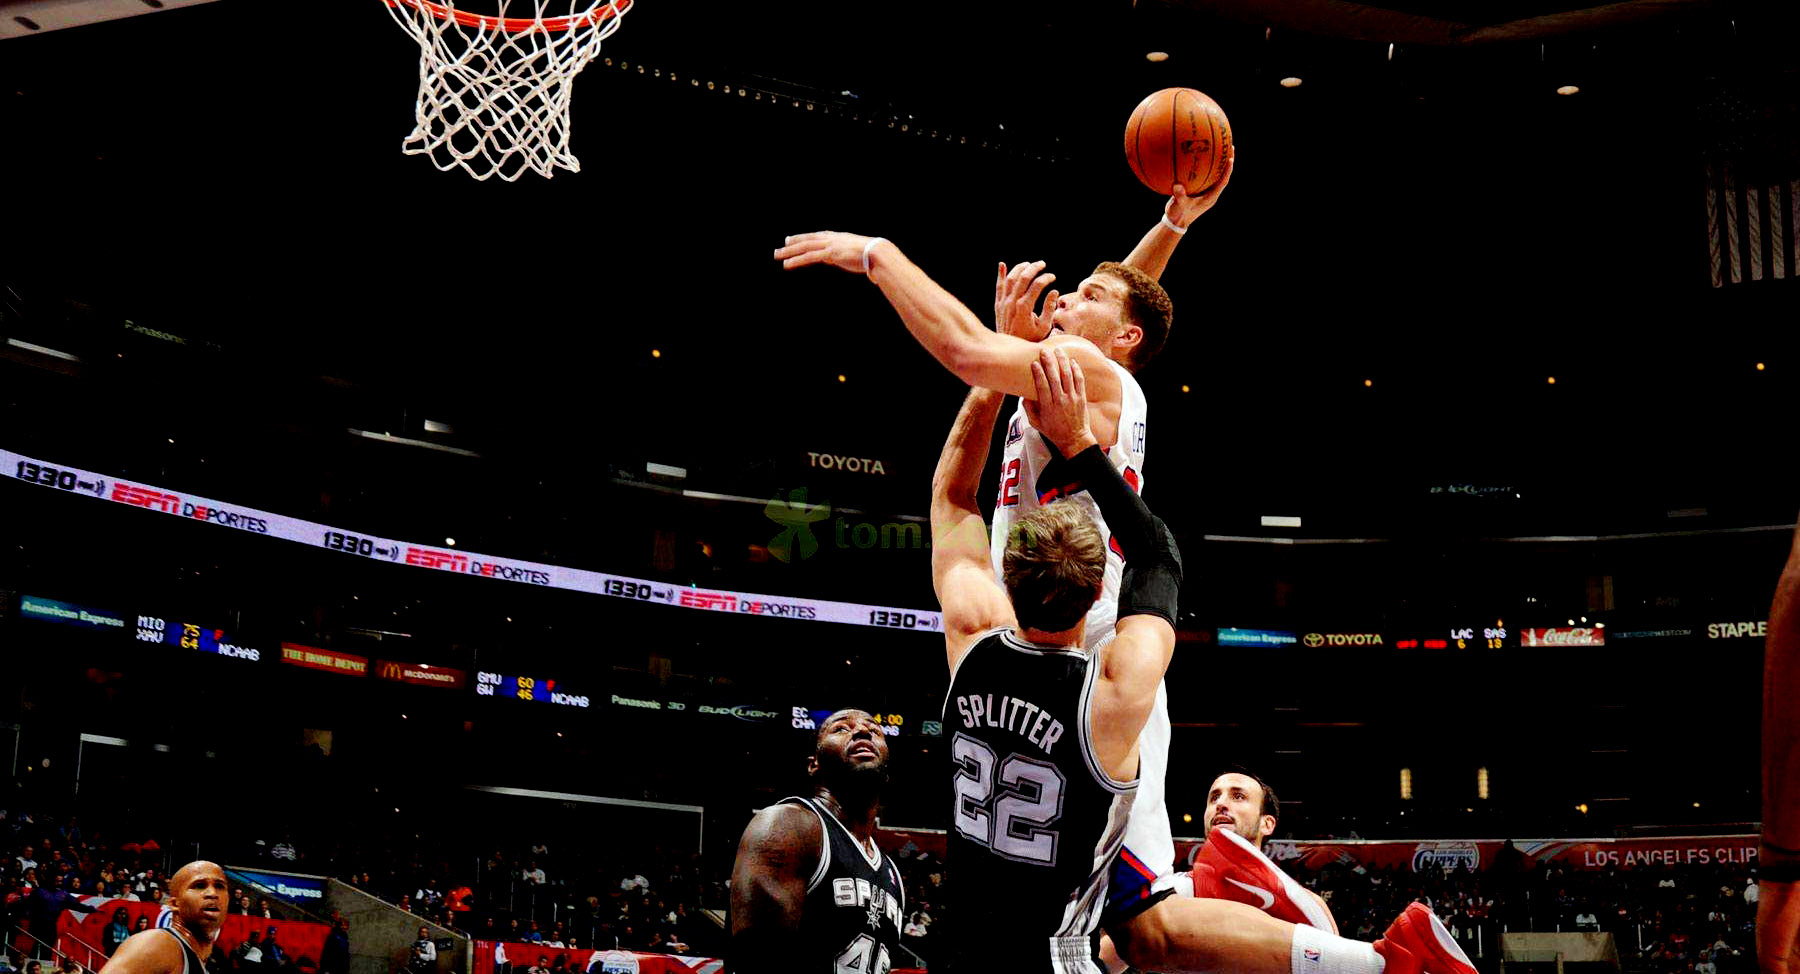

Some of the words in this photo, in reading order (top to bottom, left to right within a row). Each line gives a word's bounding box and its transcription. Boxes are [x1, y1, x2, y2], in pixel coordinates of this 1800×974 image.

[807, 451, 885, 475] TOYOTA
[17, 461, 76, 490] 1330
[112, 483, 180, 514] ESPN
[183, 503, 267, 533] DEPORTES
[324, 532, 373, 555] 1330
[406, 547, 467, 574] ESPN
[471, 561, 550, 585] DEPORTES
[604, 580, 652, 600] 1330
[680, 590, 737, 613] ESPN
[740, 600, 816, 620] DEPORTES
[21, 601, 78, 620] American
[79, 610, 125, 628] Express
[870, 610, 916, 628] 1330
[1325, 633, 1383, 646] TOYOTA
[1451, 628, 1473, 640] LAC
[1707, 621, 1768, 639] STAPLE
[281, 647, 304, 661] THE
[611, 694, 661, 710] Panasonic
[667, 701, 686, 711] 3D
[698, 705, 730, 715] BUD
[737, 708, 780, 719] LIGHT
[956, 693, 1064, 755] SPLITTER
[952, 731, 1067, 868] 22
[1584, 850, 1619, 866] LOS
[1624, 849, 1710, 866] ANGELES
[1715, 847, 1760, 864] CLIP
